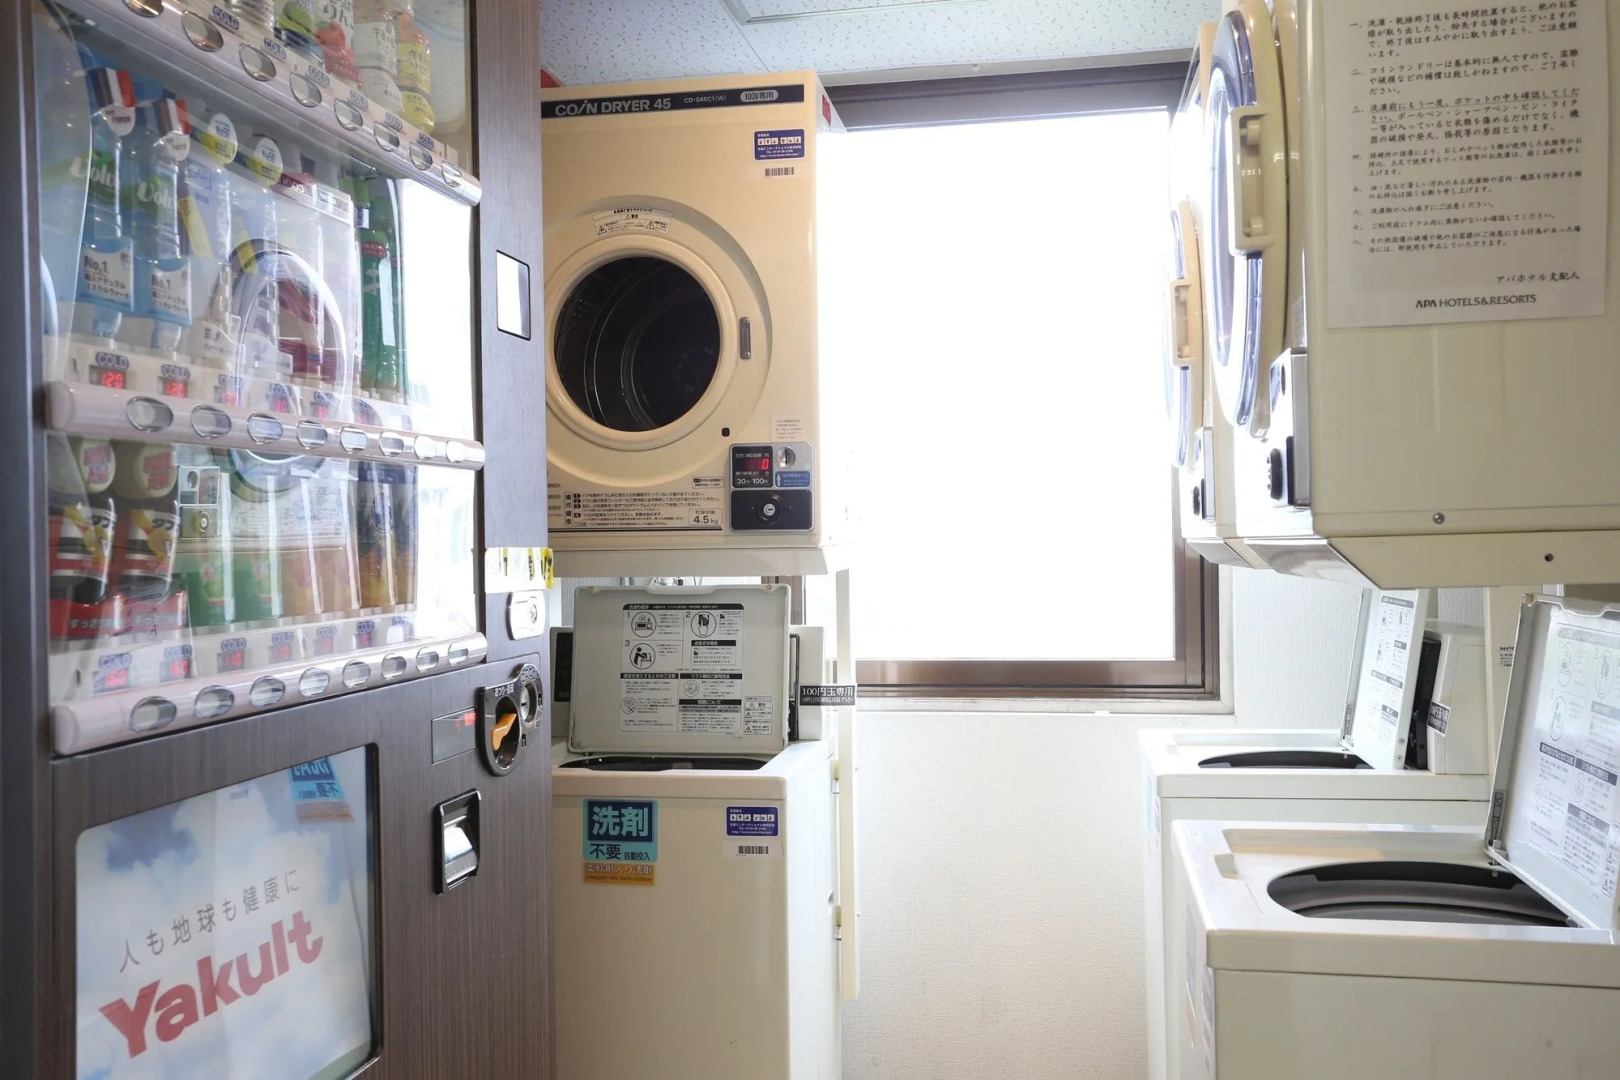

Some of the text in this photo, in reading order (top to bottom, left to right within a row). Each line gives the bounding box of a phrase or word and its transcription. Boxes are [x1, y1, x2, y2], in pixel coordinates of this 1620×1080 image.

[213, 6, 239, 30] COLD
[264, 38, 287, 60] COLD
[1368, 49, 1400, 58] います。
[1369, 88, 1401, 96] ださい。
[601, 97, 649, 113] DRYER
[653, 96, 672, 110] 45
[83, 254, 109, 273] No.1
[151, 274, 171, 290] No.1
[1415, 294, 1537, 309] APA HOTELS&RESORTS
[96, 352, 129, 370] COLD
[162, 365, 190, 379] COLD
[761, 457, 770, 470] 0
[693, 515, 710, 524] 4.5
[685, 611, 691, 619] 2
[222, 638, 246, 652] COLD
[624, 639, 631, 647] 3
[801, 686, 854, 697] 100円玉専用
[592, 805, 650, 838] 洗剤
[589, 842, 651, 861] 不要 自動投入
[586, 863, 654, 876] 柔軟剤入り洗剤
[119, 869, 301, 975] 人も地球も健康に
[98, 909, 324, 1059] Yakult
